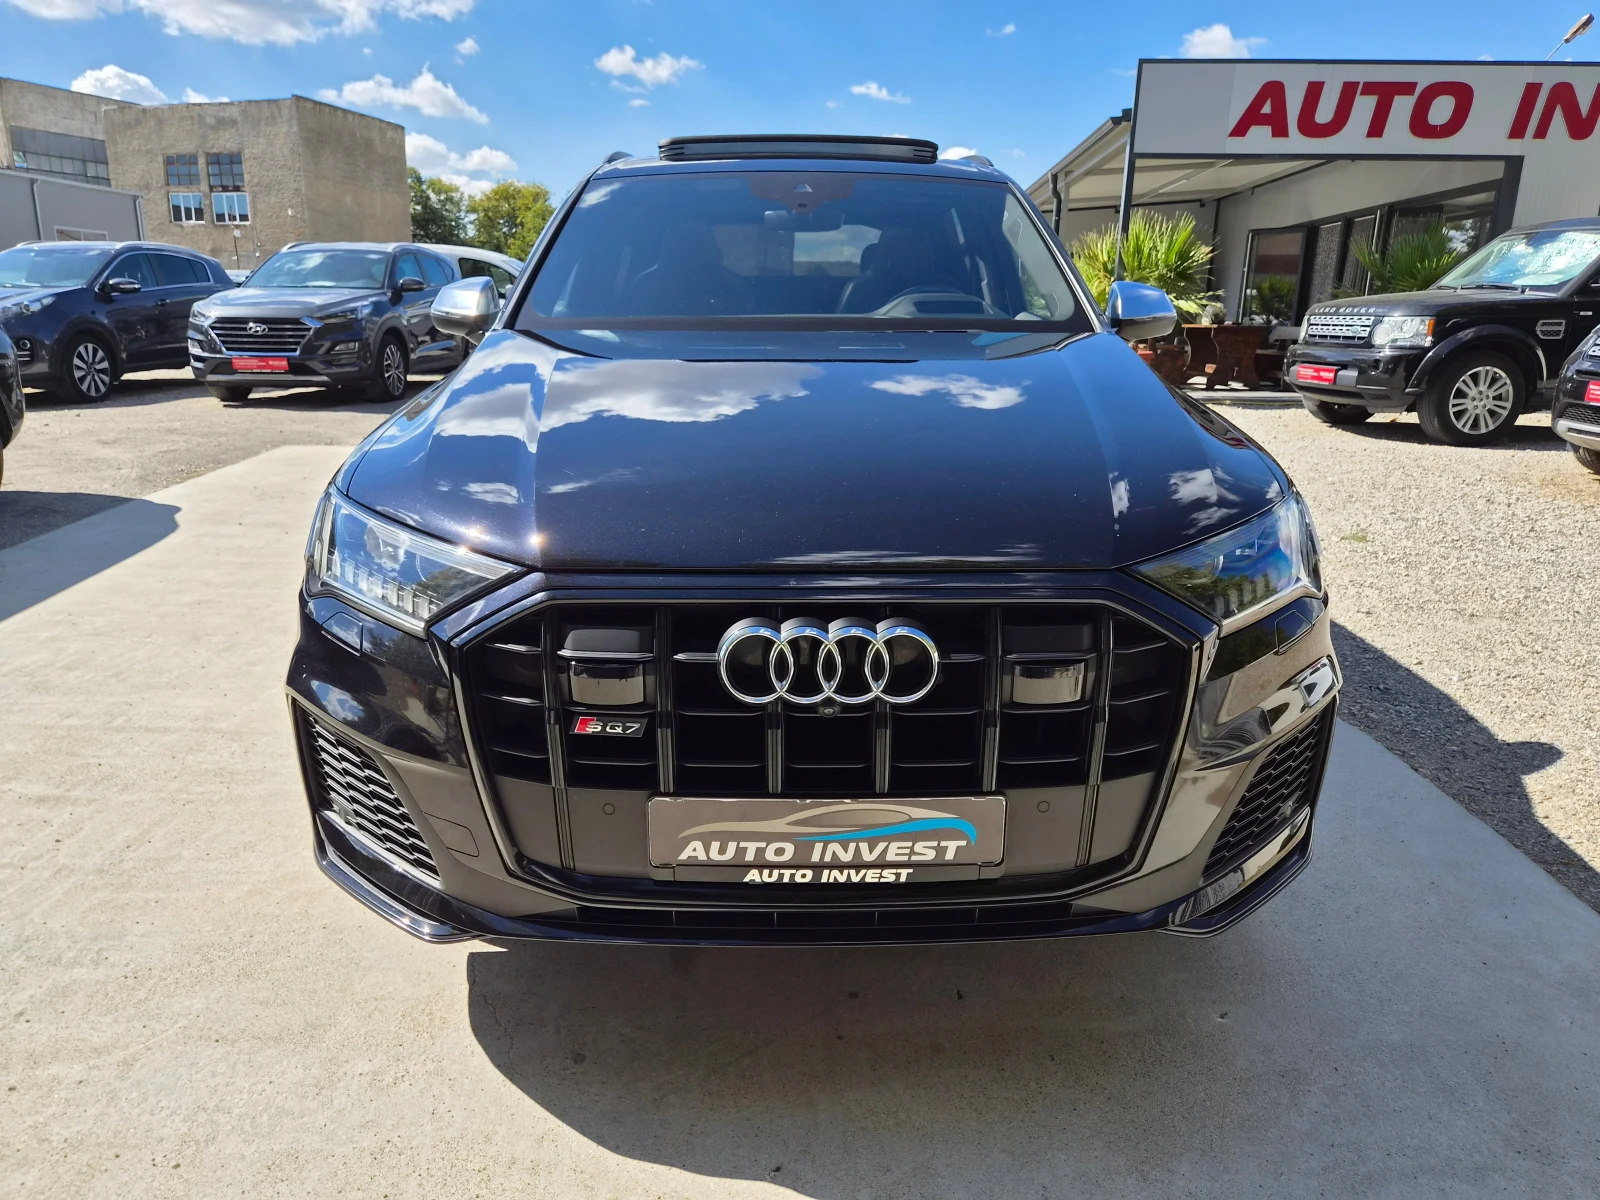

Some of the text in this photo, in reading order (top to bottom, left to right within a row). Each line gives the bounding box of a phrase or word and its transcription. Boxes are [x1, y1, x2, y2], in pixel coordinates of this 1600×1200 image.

[1228, 80, 1600, 141] AUTO IN
[585, 720, 641, 734] SQ7
[677, 840, 968, 862] AUTO INVEST
[743, 868, 914, 883] AUTO INVEST
